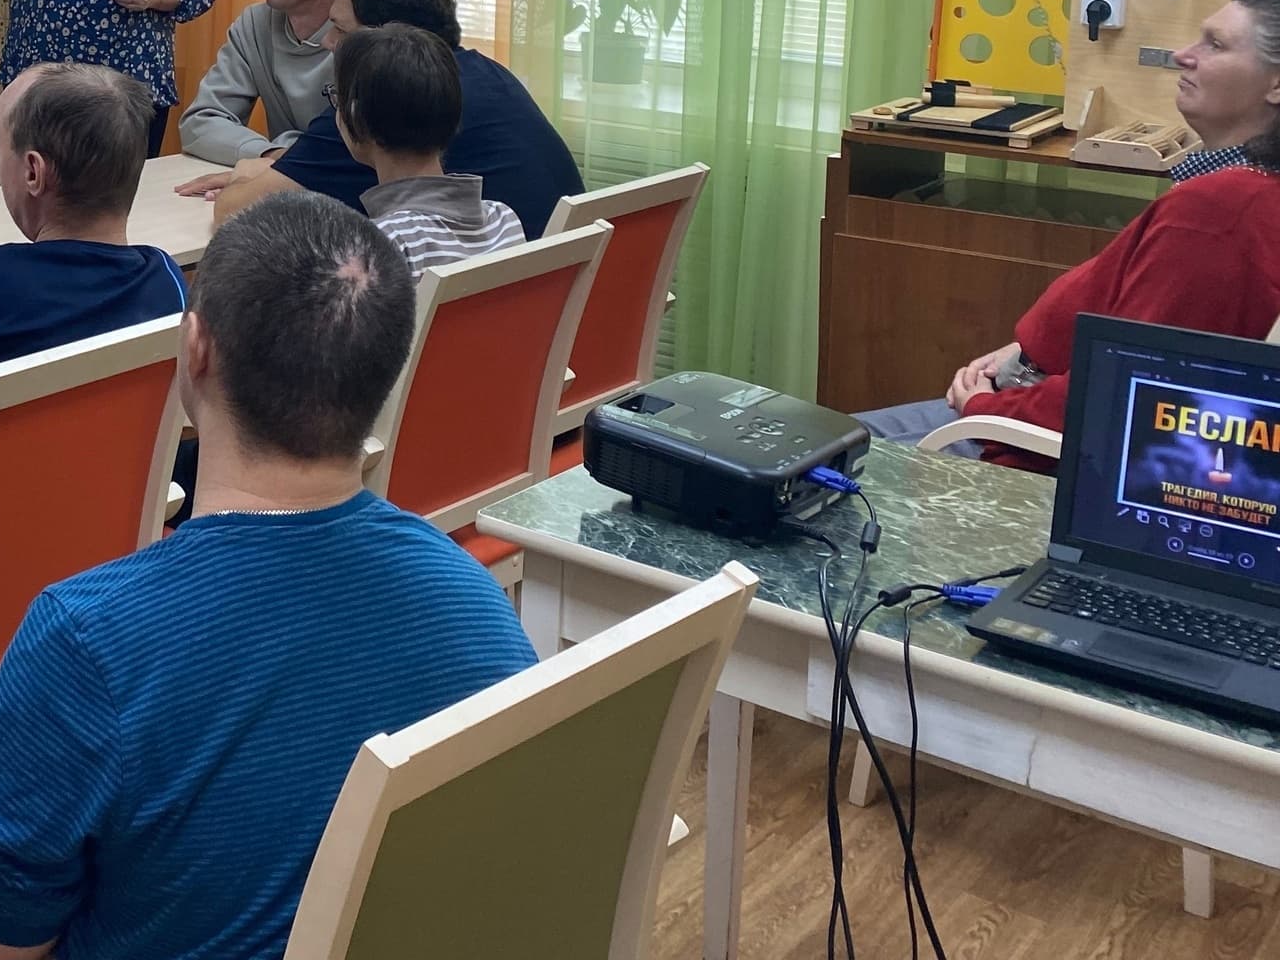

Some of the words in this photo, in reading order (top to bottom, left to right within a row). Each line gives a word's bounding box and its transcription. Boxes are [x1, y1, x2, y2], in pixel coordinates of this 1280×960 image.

[1163, 494, 1200, 511] НИКТО
[1201, 502, 1217, 514] НЕ
[1219, 506, 1272, 526] ЗАБУДЕТ
[1222, 494, 1277, 515] КОТОРУЮ
